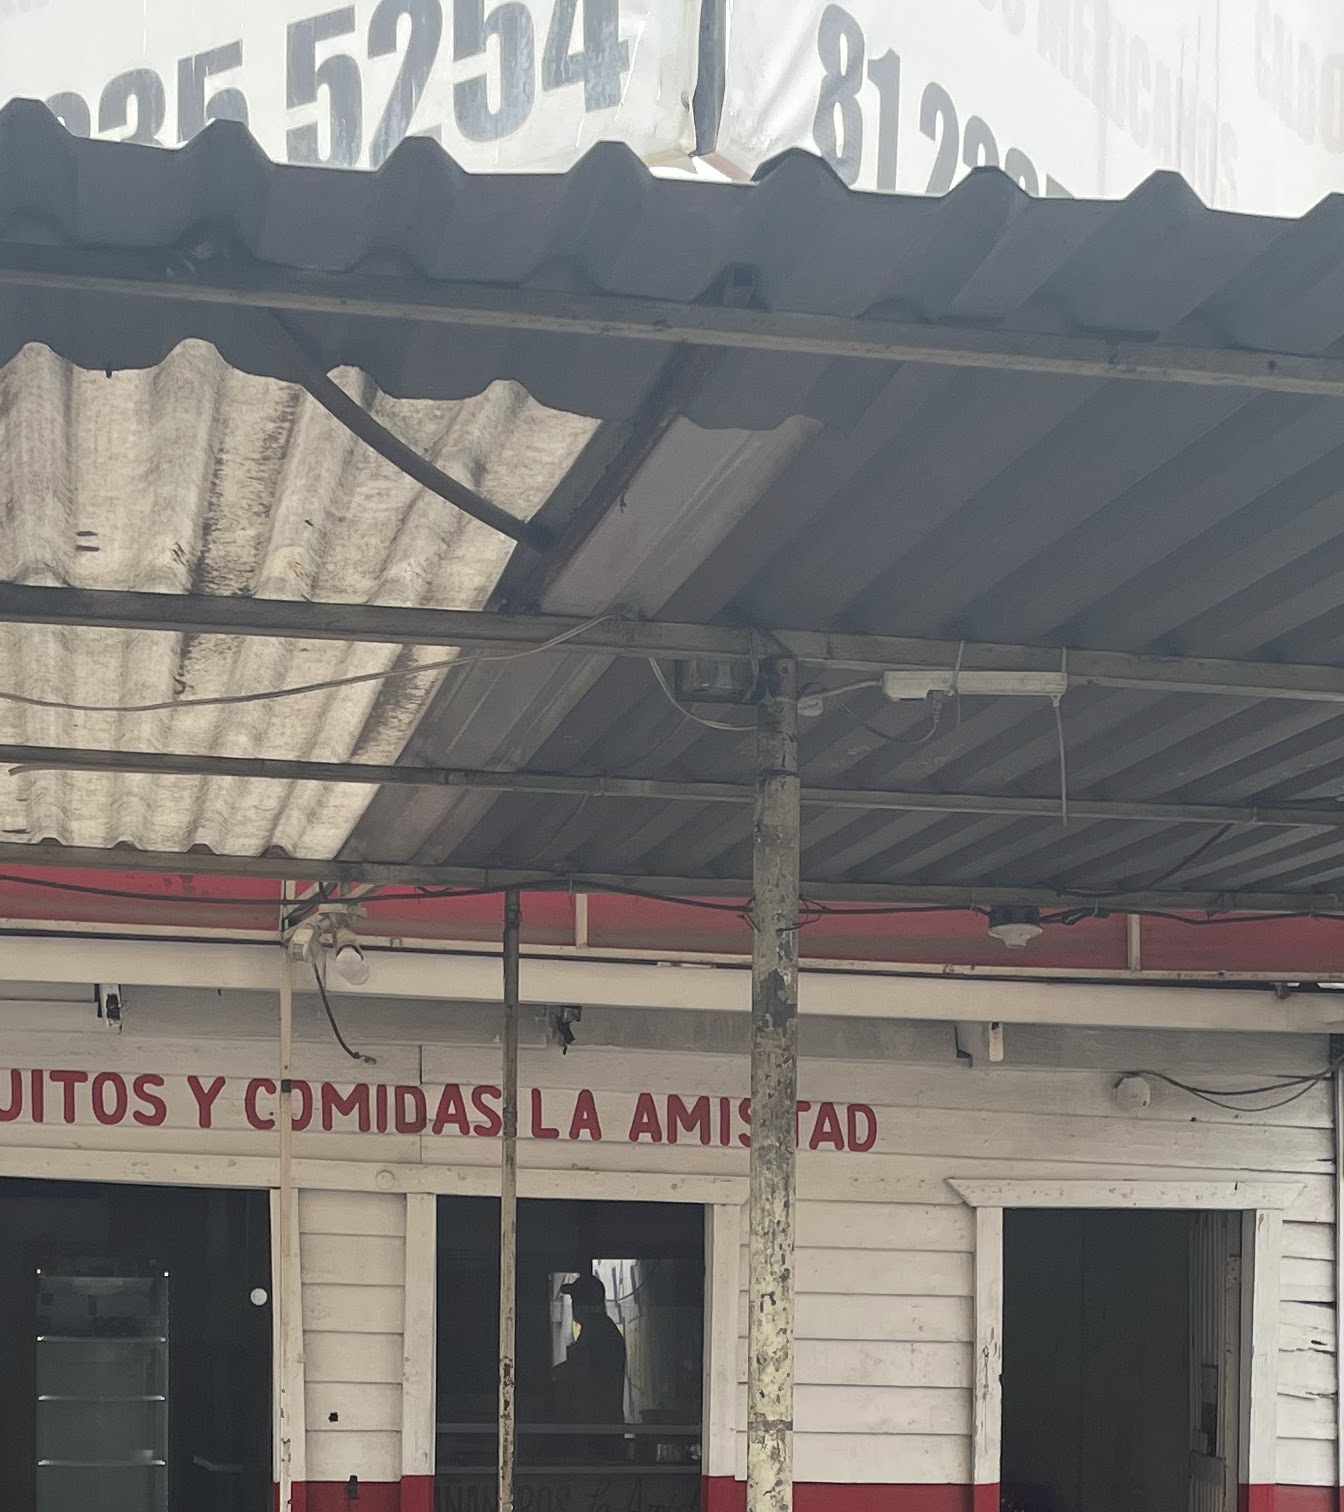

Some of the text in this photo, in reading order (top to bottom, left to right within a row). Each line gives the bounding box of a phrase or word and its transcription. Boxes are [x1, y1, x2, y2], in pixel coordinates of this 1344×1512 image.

[187, 1075, 227, 1129] Y
[244, 1078, 503, 1137] COMIDAS
[530, 1088, 602, 1141] LA
